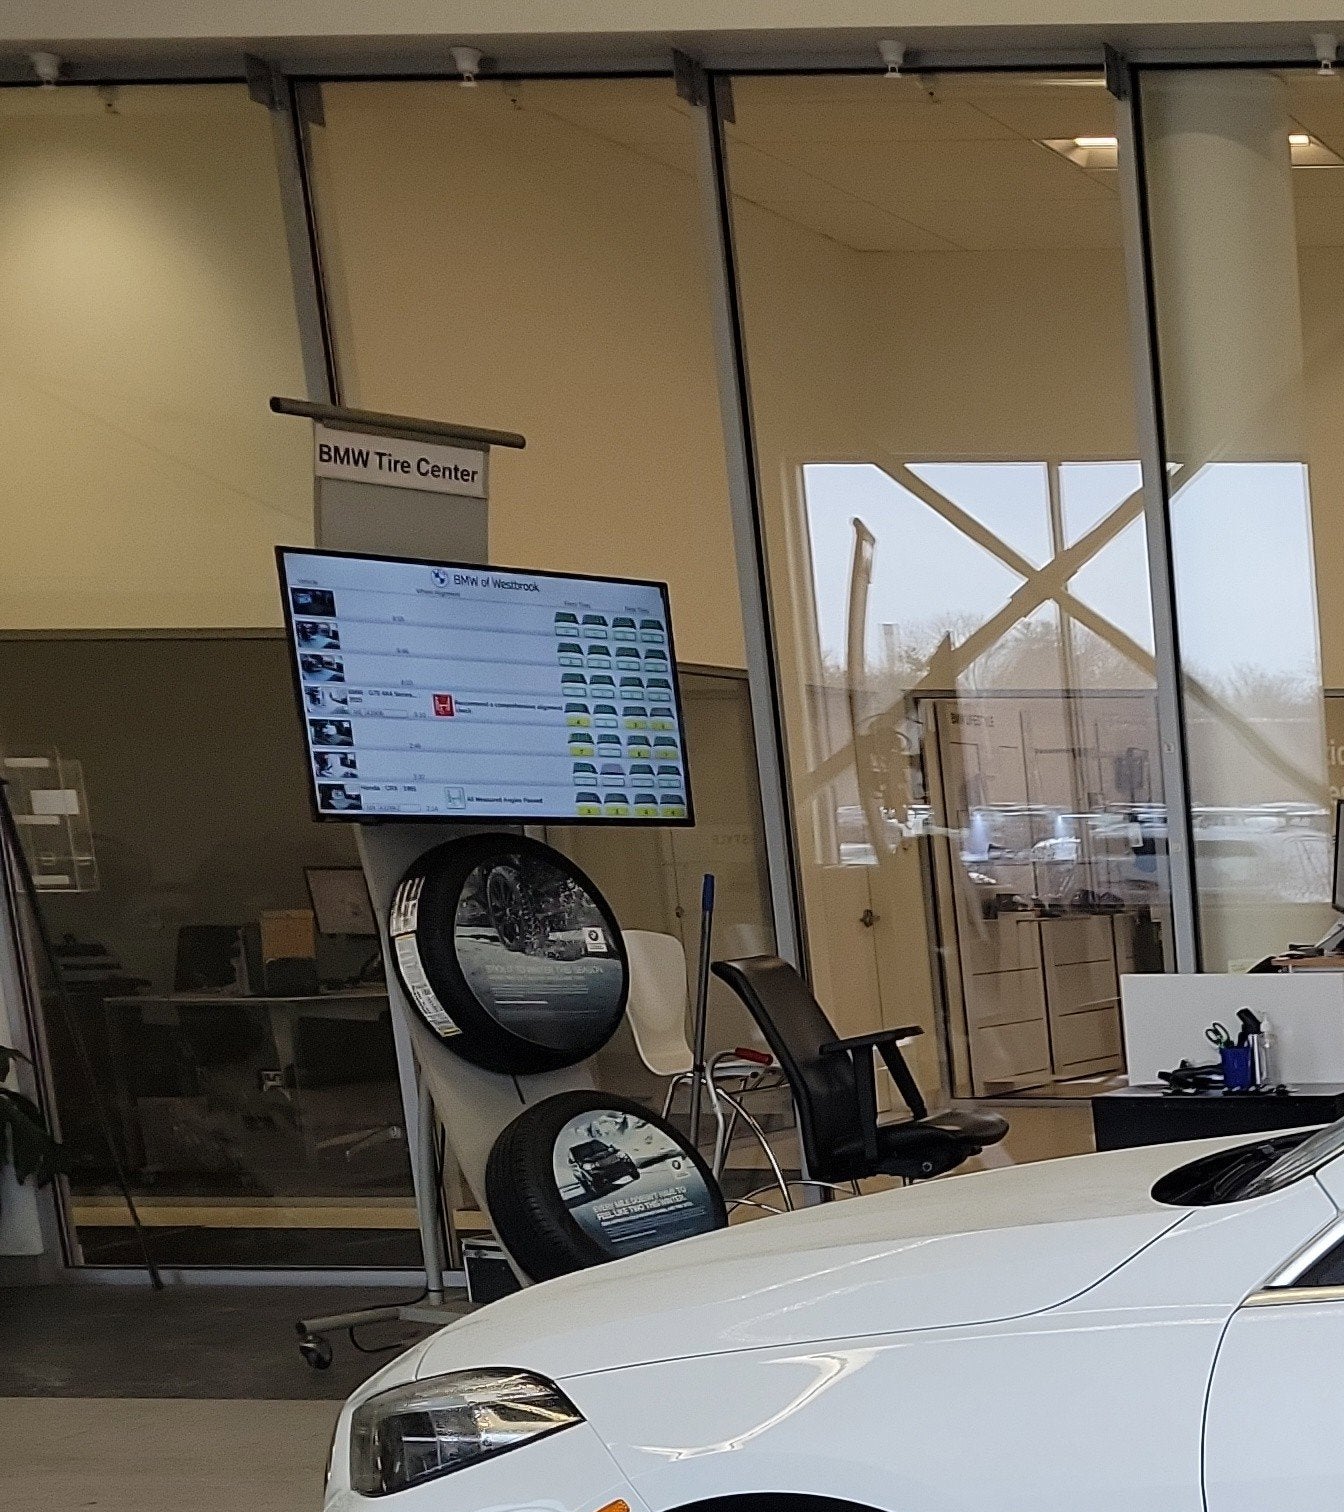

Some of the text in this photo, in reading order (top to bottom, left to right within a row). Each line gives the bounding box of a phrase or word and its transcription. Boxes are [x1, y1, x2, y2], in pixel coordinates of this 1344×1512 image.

[318, 444, 479, 483] BMW Tire Center
[453, 574, 540, 592] BMW of Westbrook
